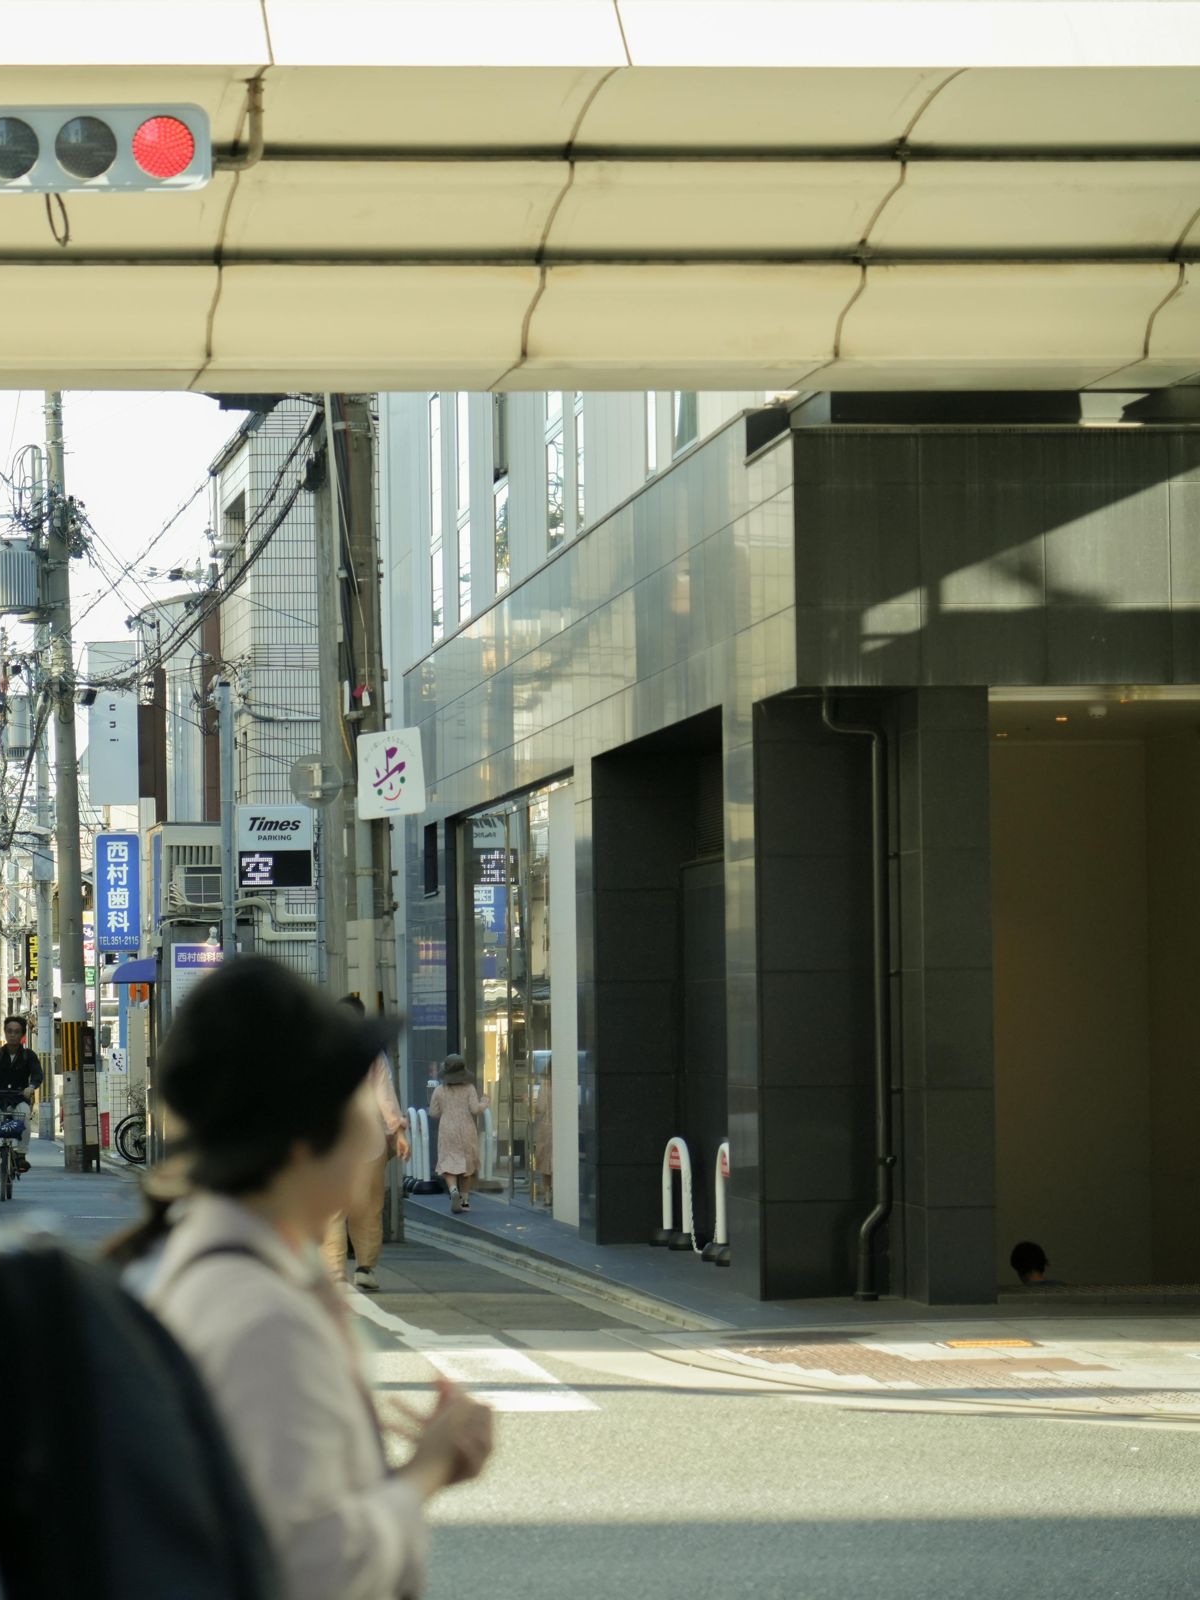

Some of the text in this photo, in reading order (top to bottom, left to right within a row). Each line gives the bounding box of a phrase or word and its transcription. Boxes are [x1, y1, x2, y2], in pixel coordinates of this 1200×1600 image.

[248, 817, 301, 831] Times
[241, 853, 273, 885] 空
[106, 841, 129, 933] 西村歯科
